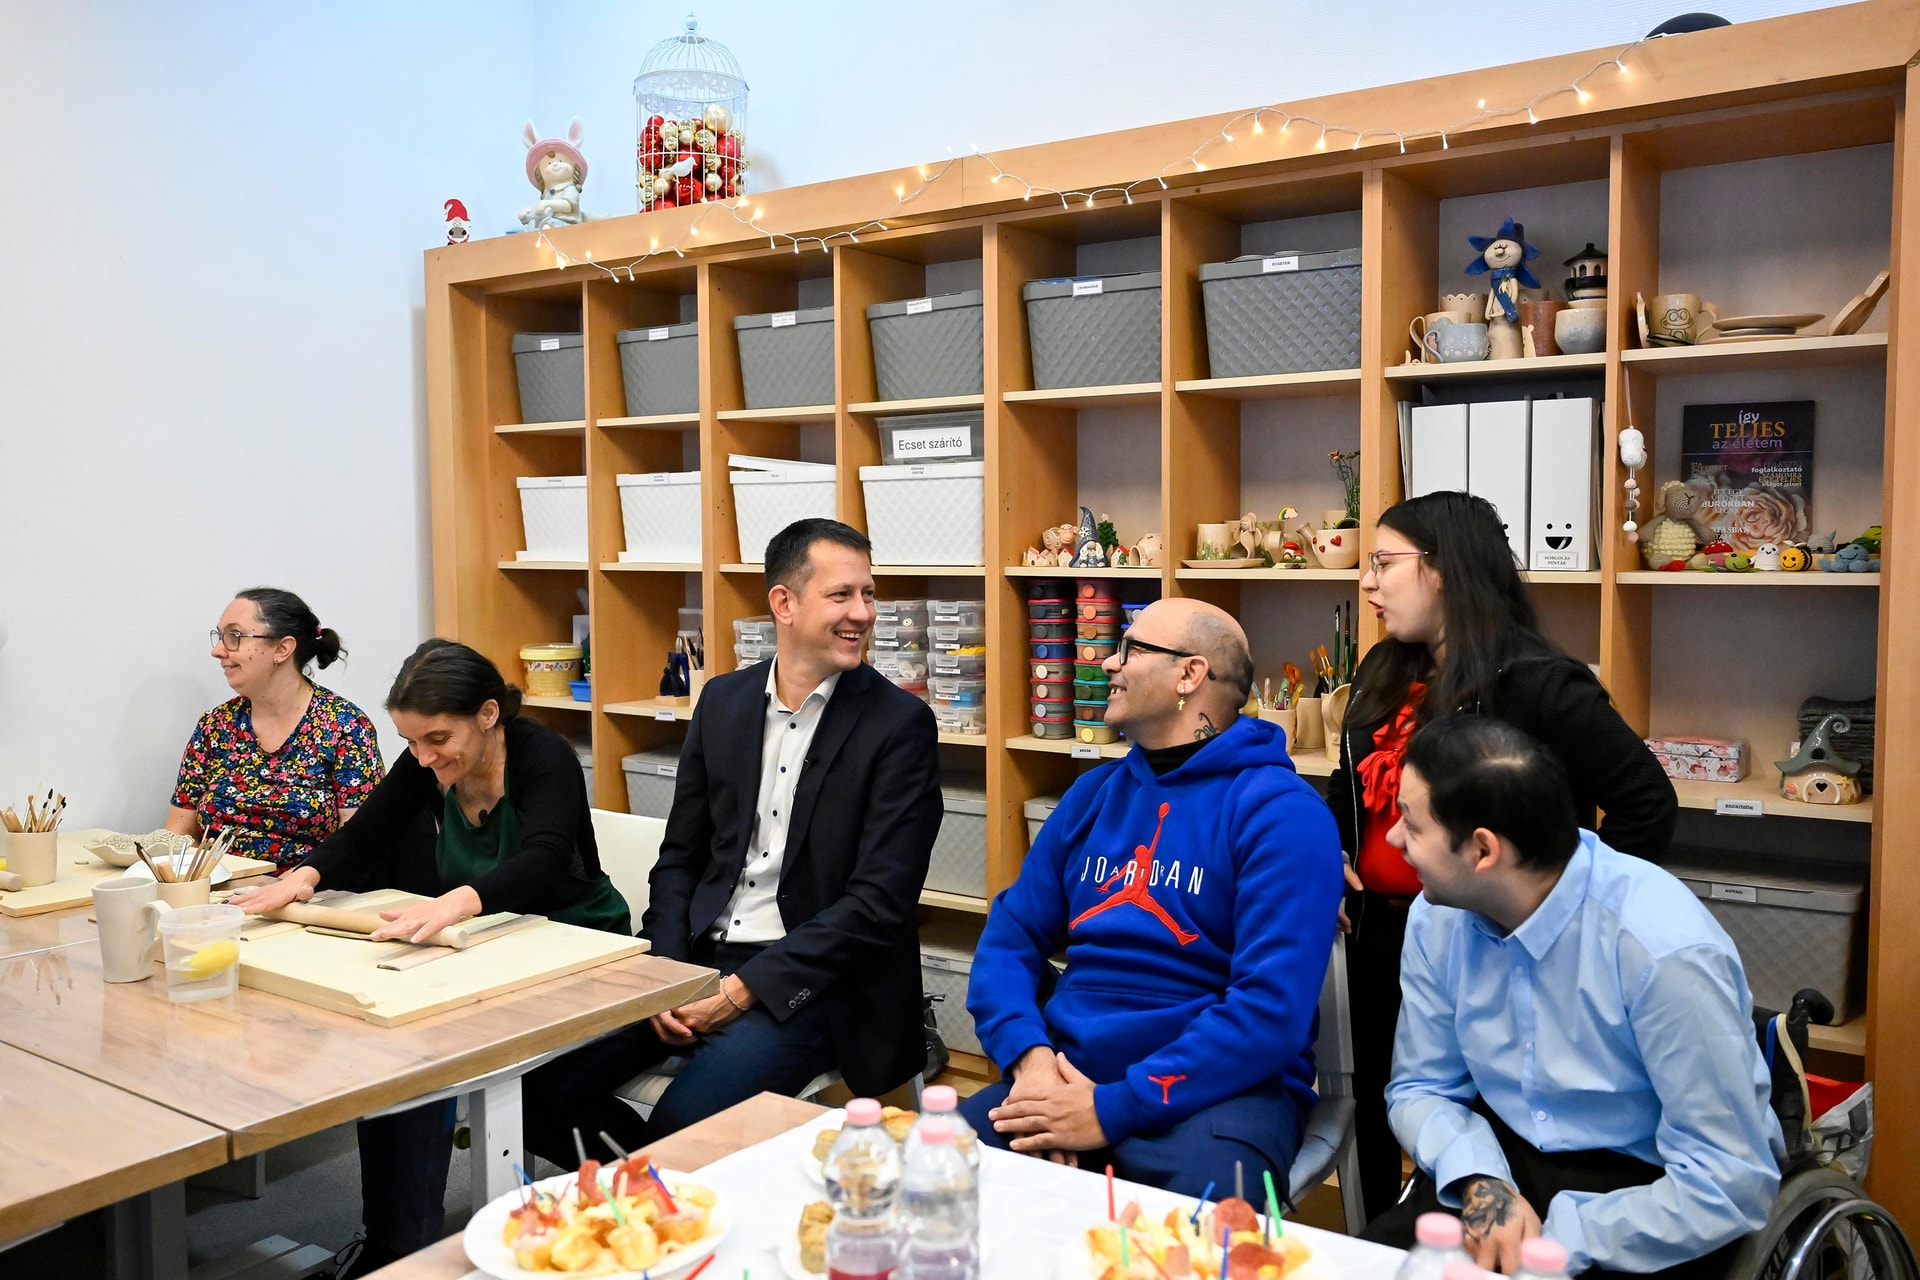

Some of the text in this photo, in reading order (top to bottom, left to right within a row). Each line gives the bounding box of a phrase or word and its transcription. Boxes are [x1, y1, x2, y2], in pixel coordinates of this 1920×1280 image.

[1738, 410, 1760, 424] így
[1710, 421, 1786, 439] TELJES
[898, 436, 963, 451] Ecset szárító
[1712, 437, 1783, 449] az életem
[1751, 466, 1803, 474] foglalkoztató
[1080, 856, 1204, 895] JORDAN
